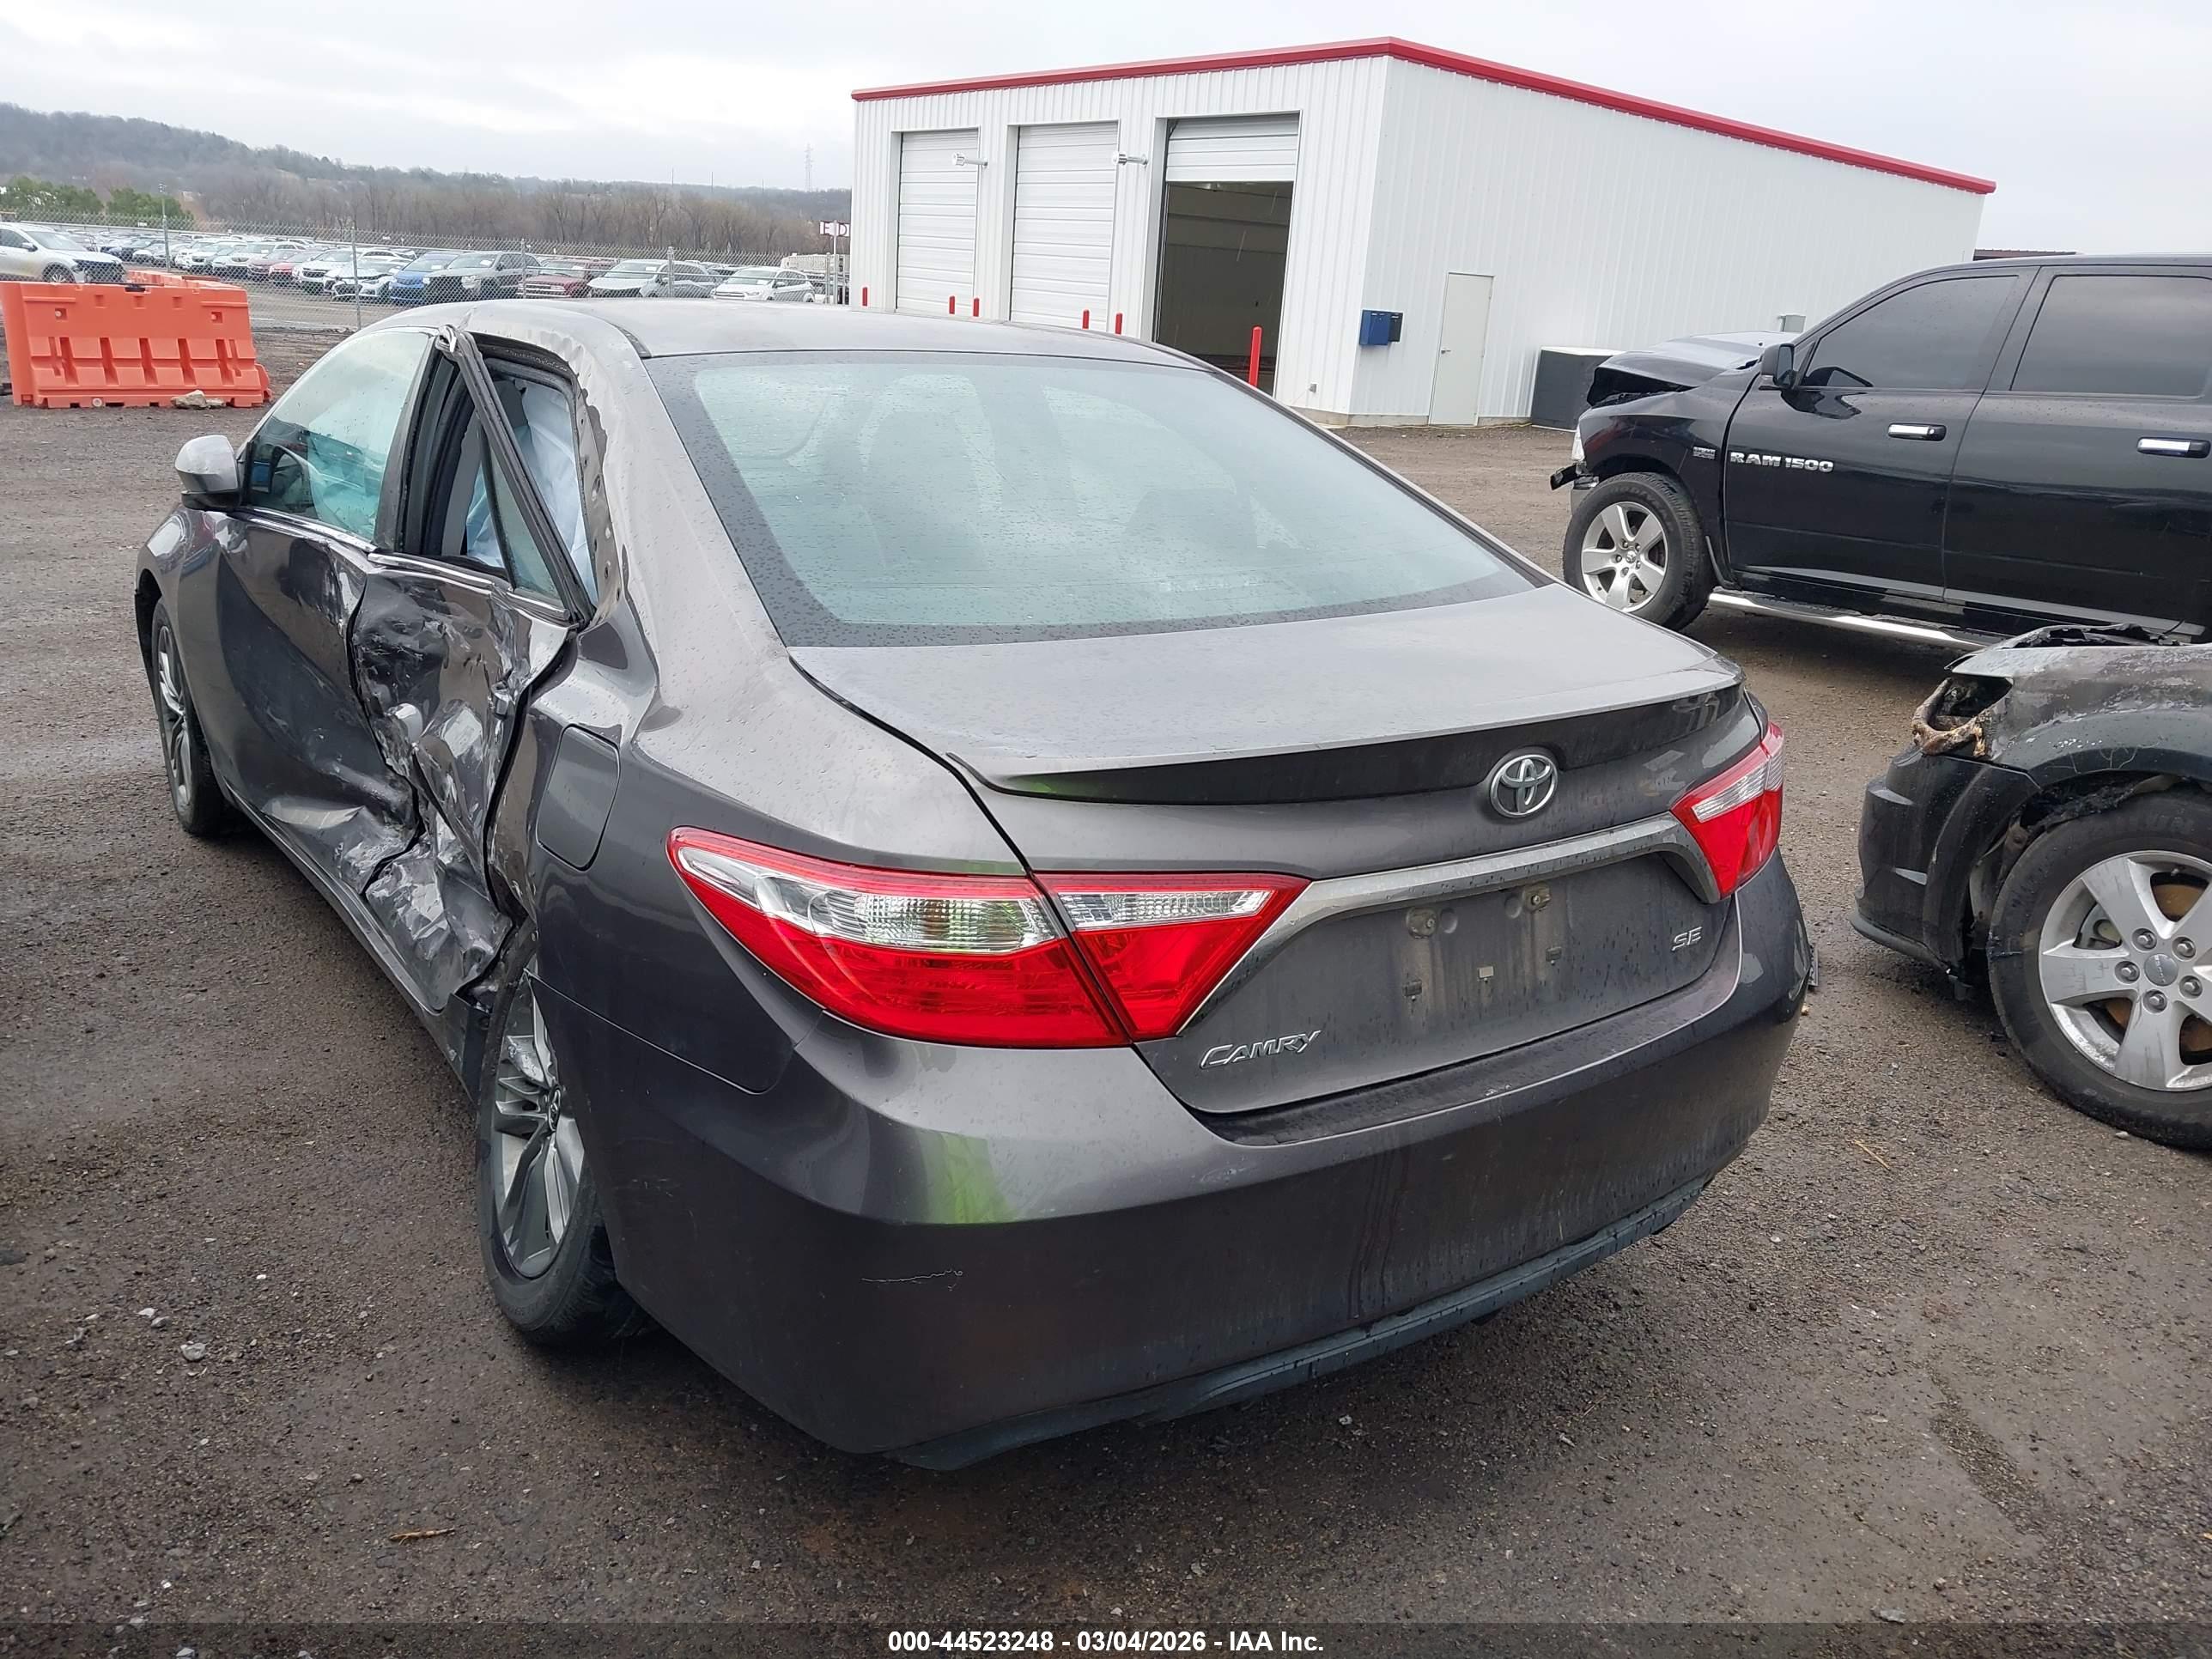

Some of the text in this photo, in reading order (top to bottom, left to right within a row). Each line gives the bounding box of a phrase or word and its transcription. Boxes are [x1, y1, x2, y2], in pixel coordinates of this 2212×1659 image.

[1730, 452, 1782, 467] RAM
[1785, 457, 1834, 472] 1500
[1671, 926, 1703, 951] SE
[1200, 1030, 1322, 1069] CAMRY
